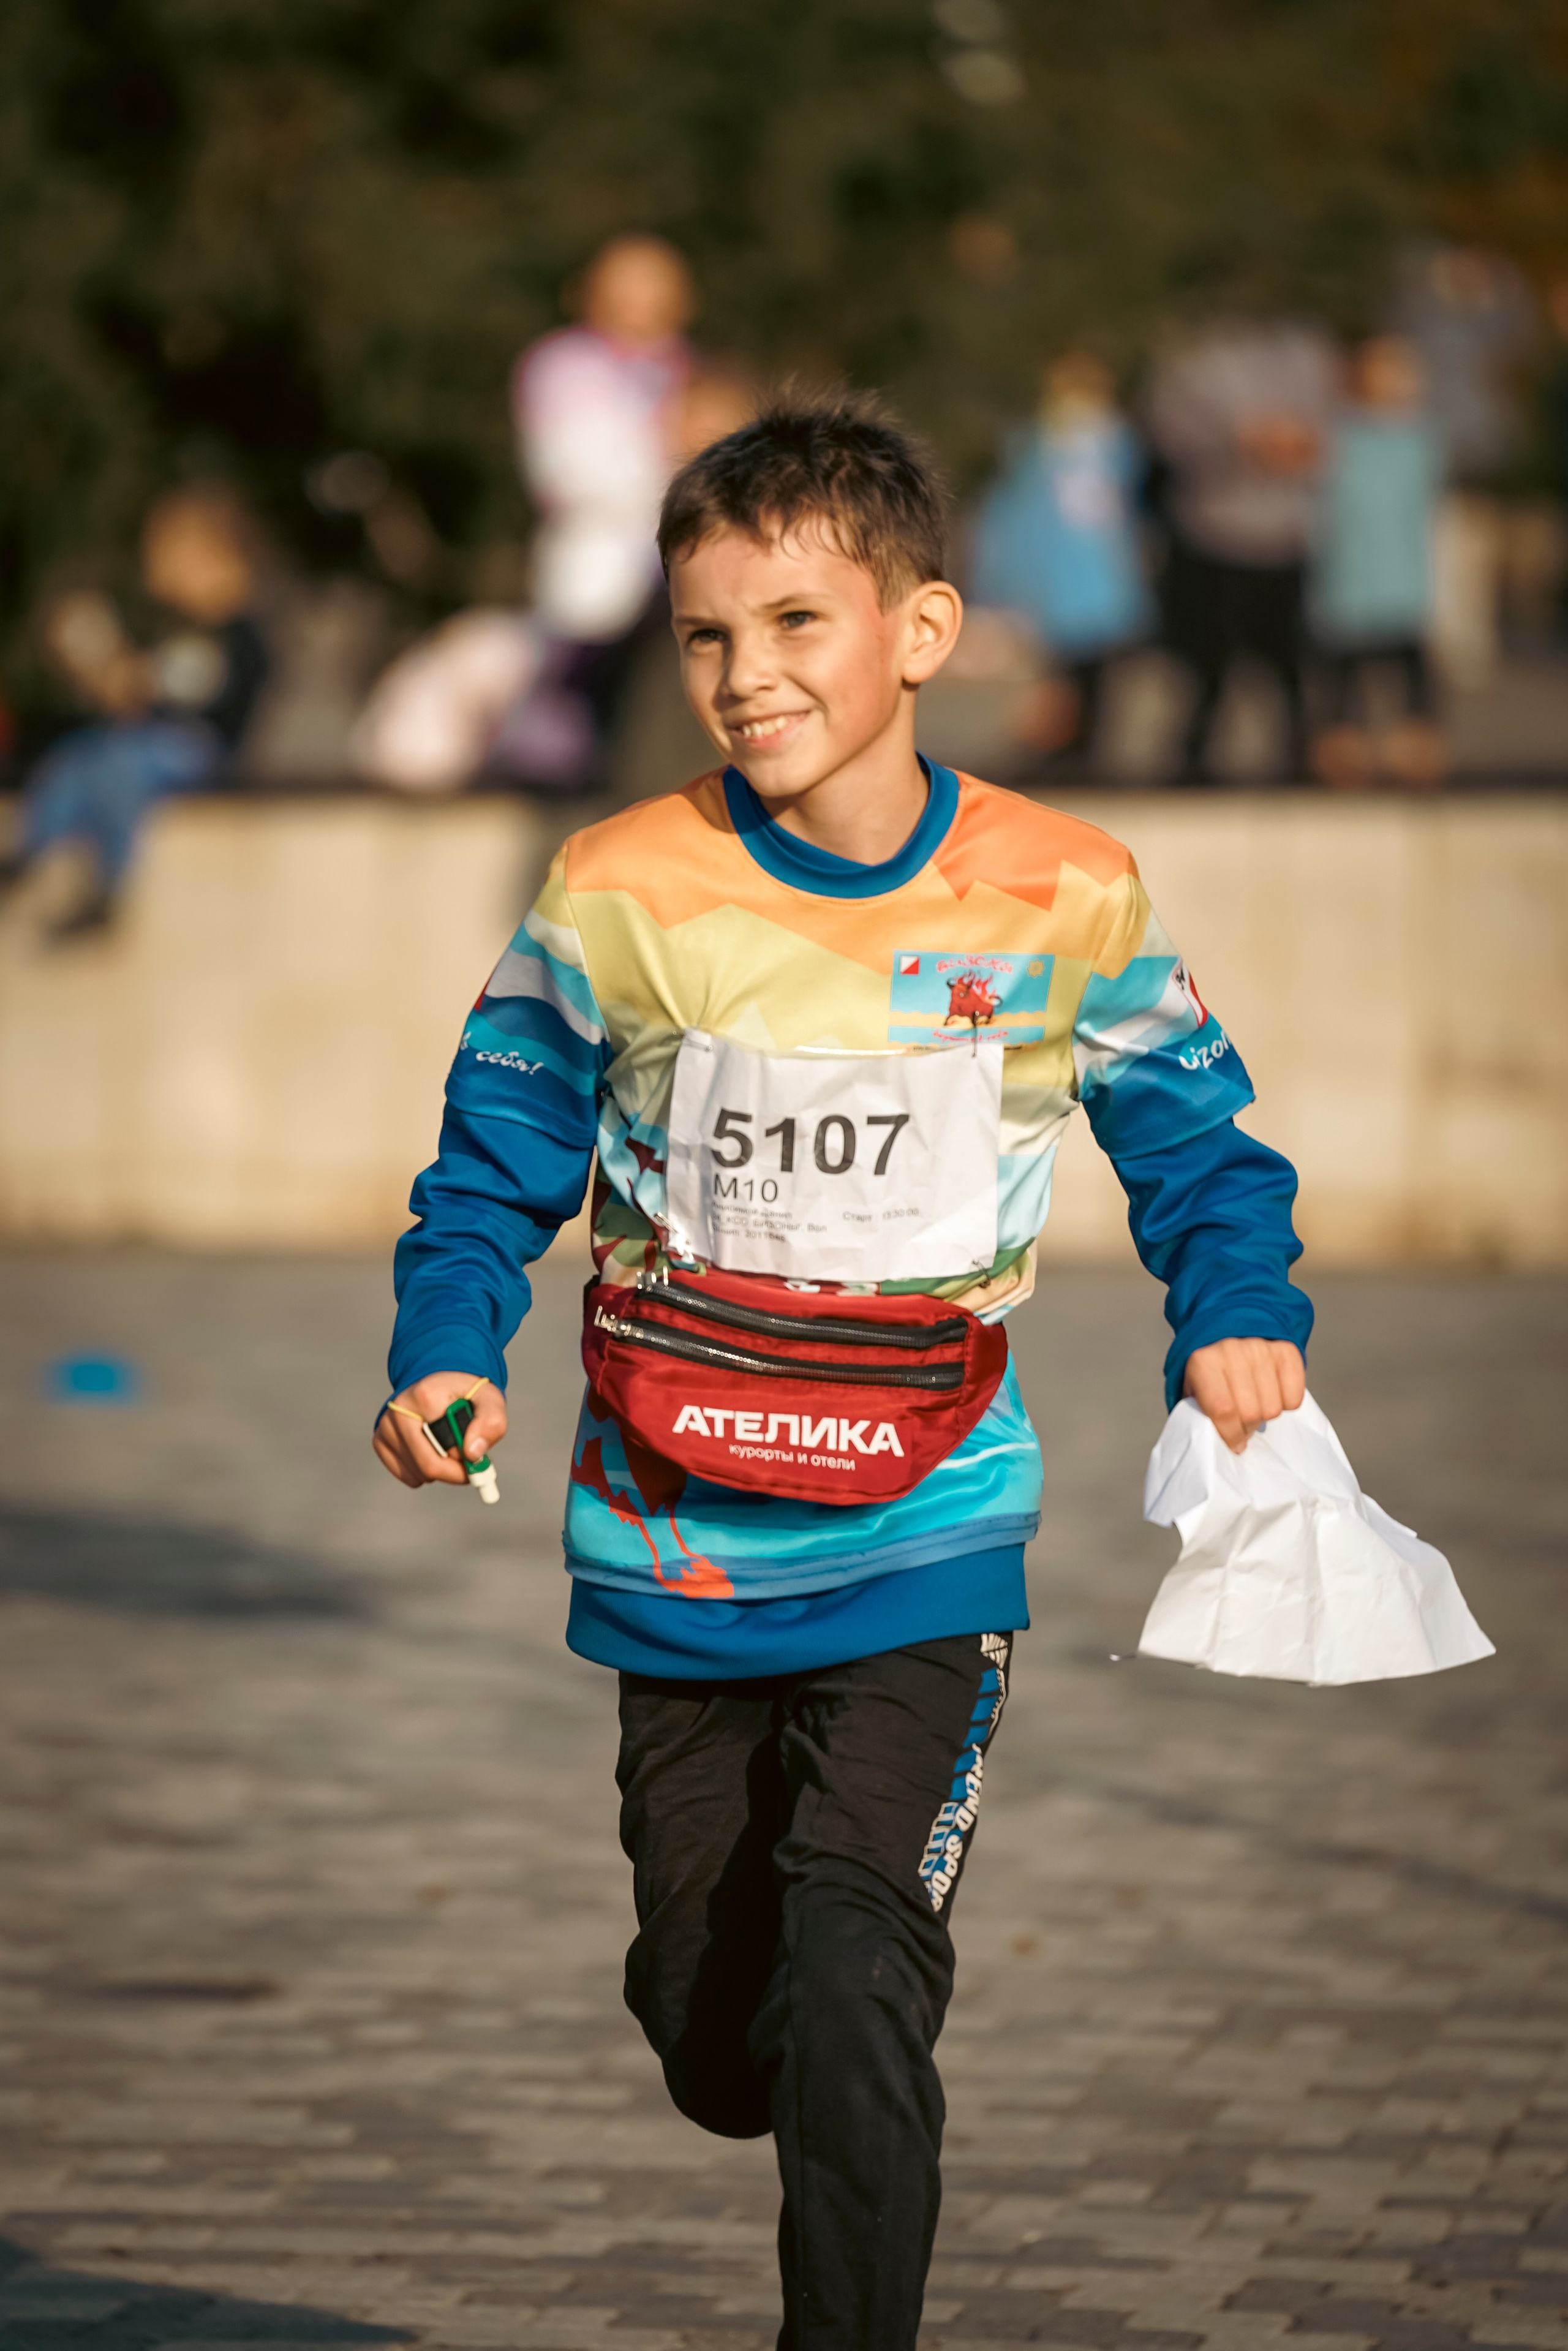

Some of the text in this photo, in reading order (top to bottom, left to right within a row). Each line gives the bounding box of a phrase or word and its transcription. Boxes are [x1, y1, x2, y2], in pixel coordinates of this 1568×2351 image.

[710, 1108, 910, 1176] 5107
[672, 1405, 905, 1457] АТЕЛИКА
[728, 1444, 856, 1471] курорты и отели
